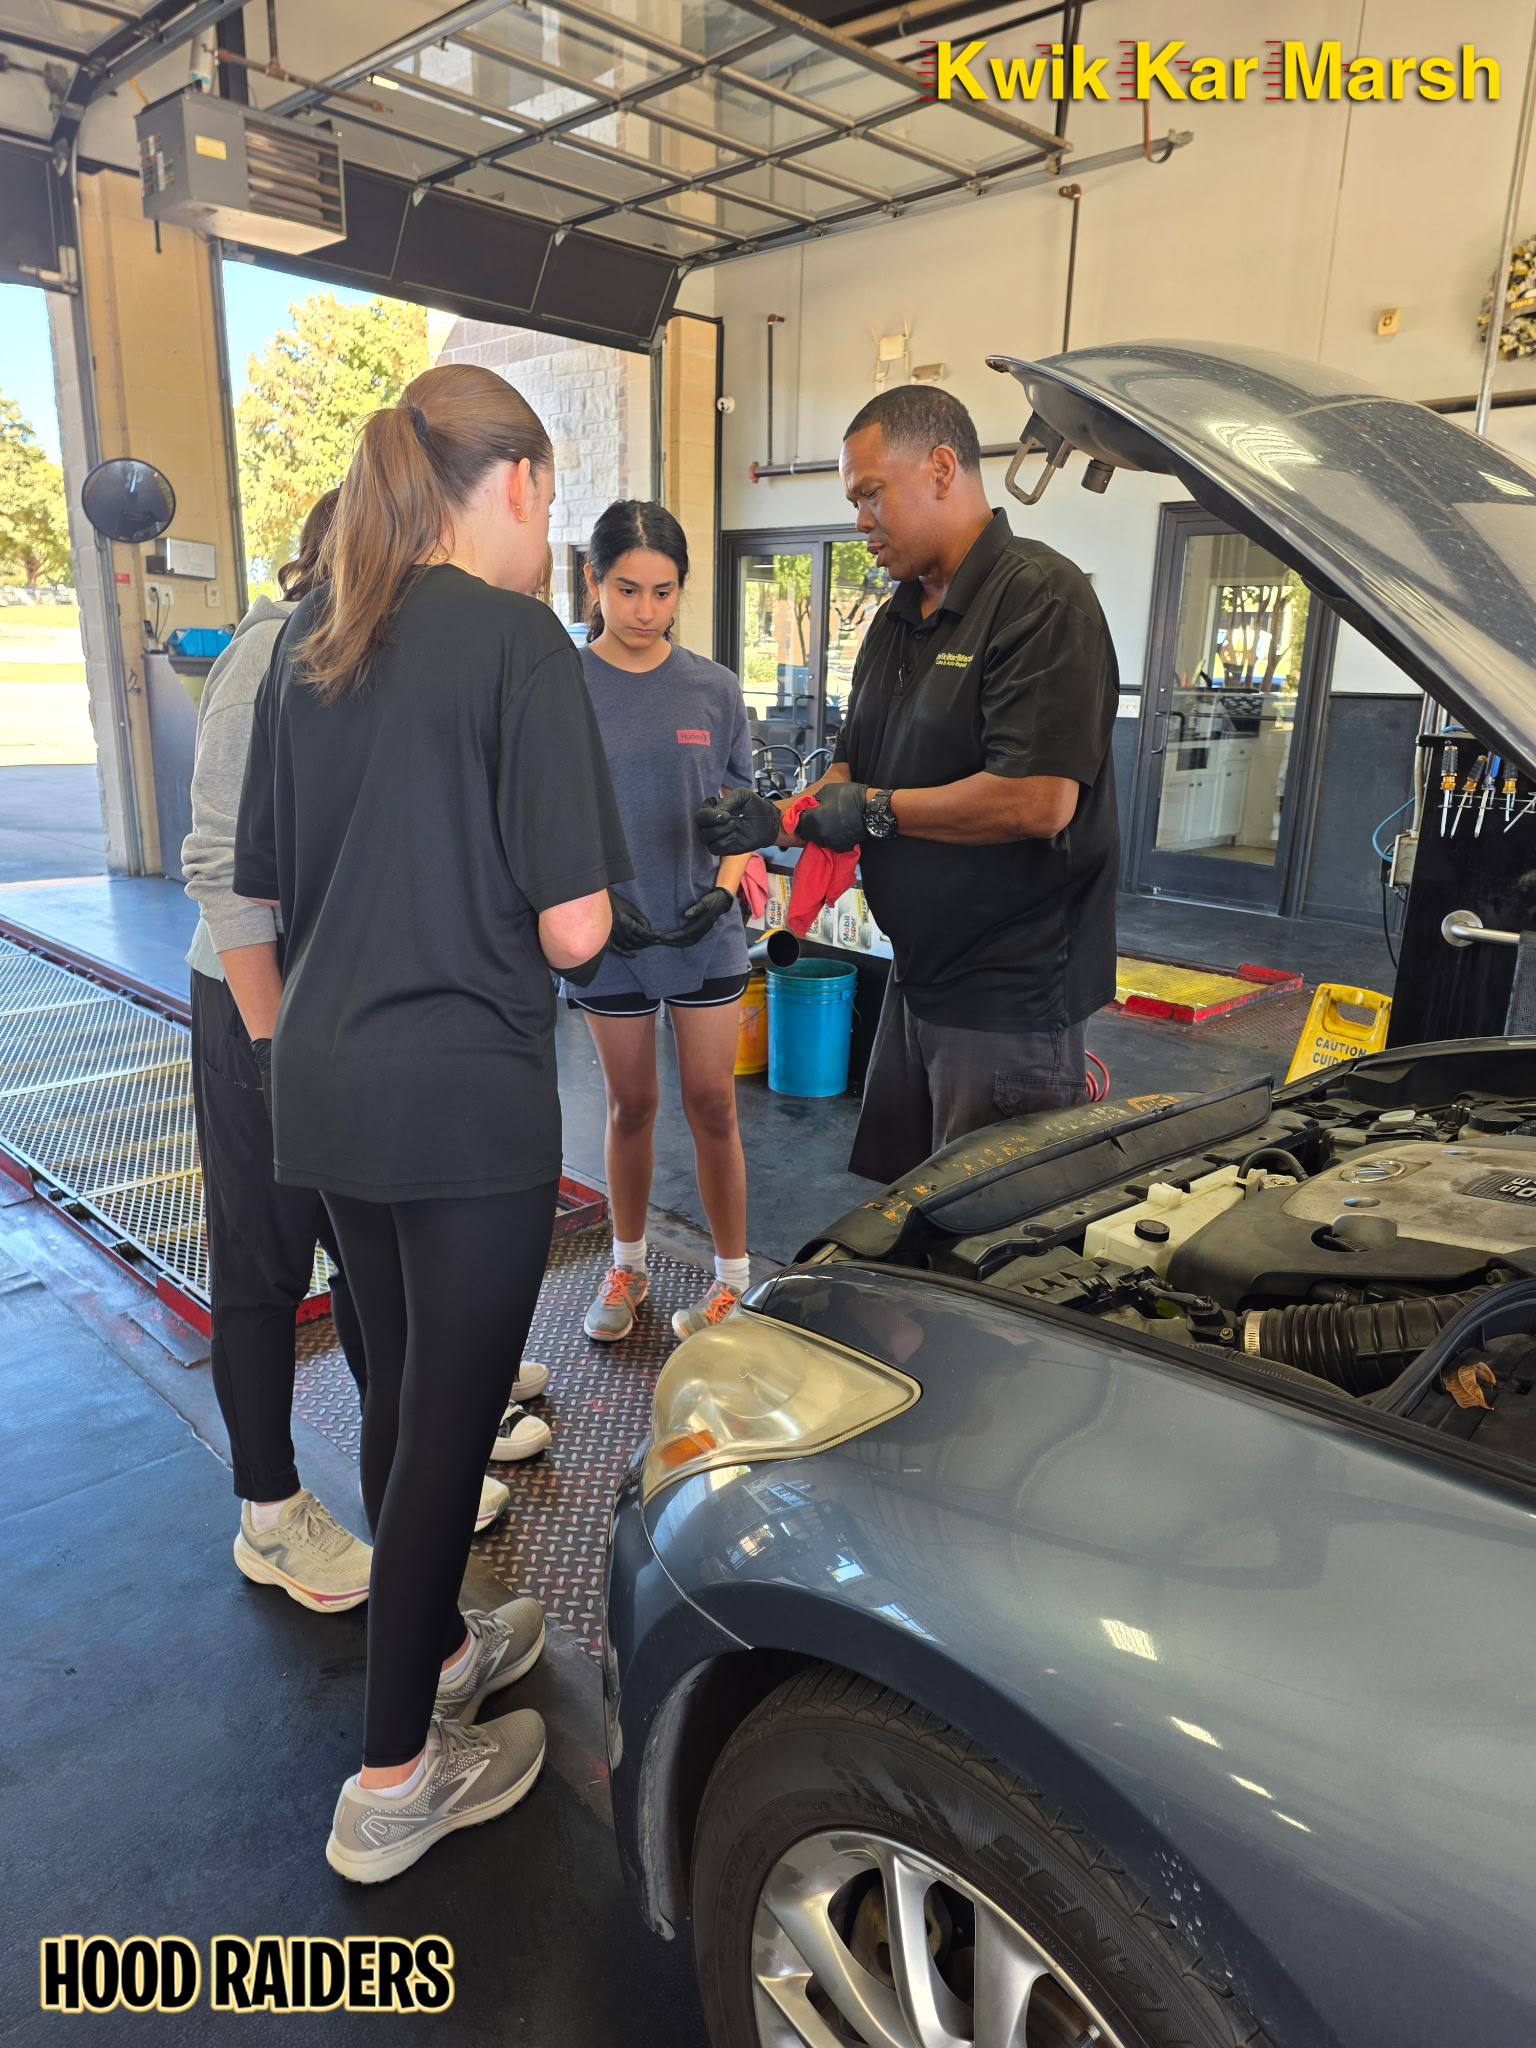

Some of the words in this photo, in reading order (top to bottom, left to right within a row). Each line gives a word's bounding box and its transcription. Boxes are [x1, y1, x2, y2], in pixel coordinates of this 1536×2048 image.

[681, 733, 702, 742] Hurley
[849, 917, 857, 943] Super
[1315, 1036, 1367, 1057] CAUTION
[1312, 1052, 1345, 1067] CUID
